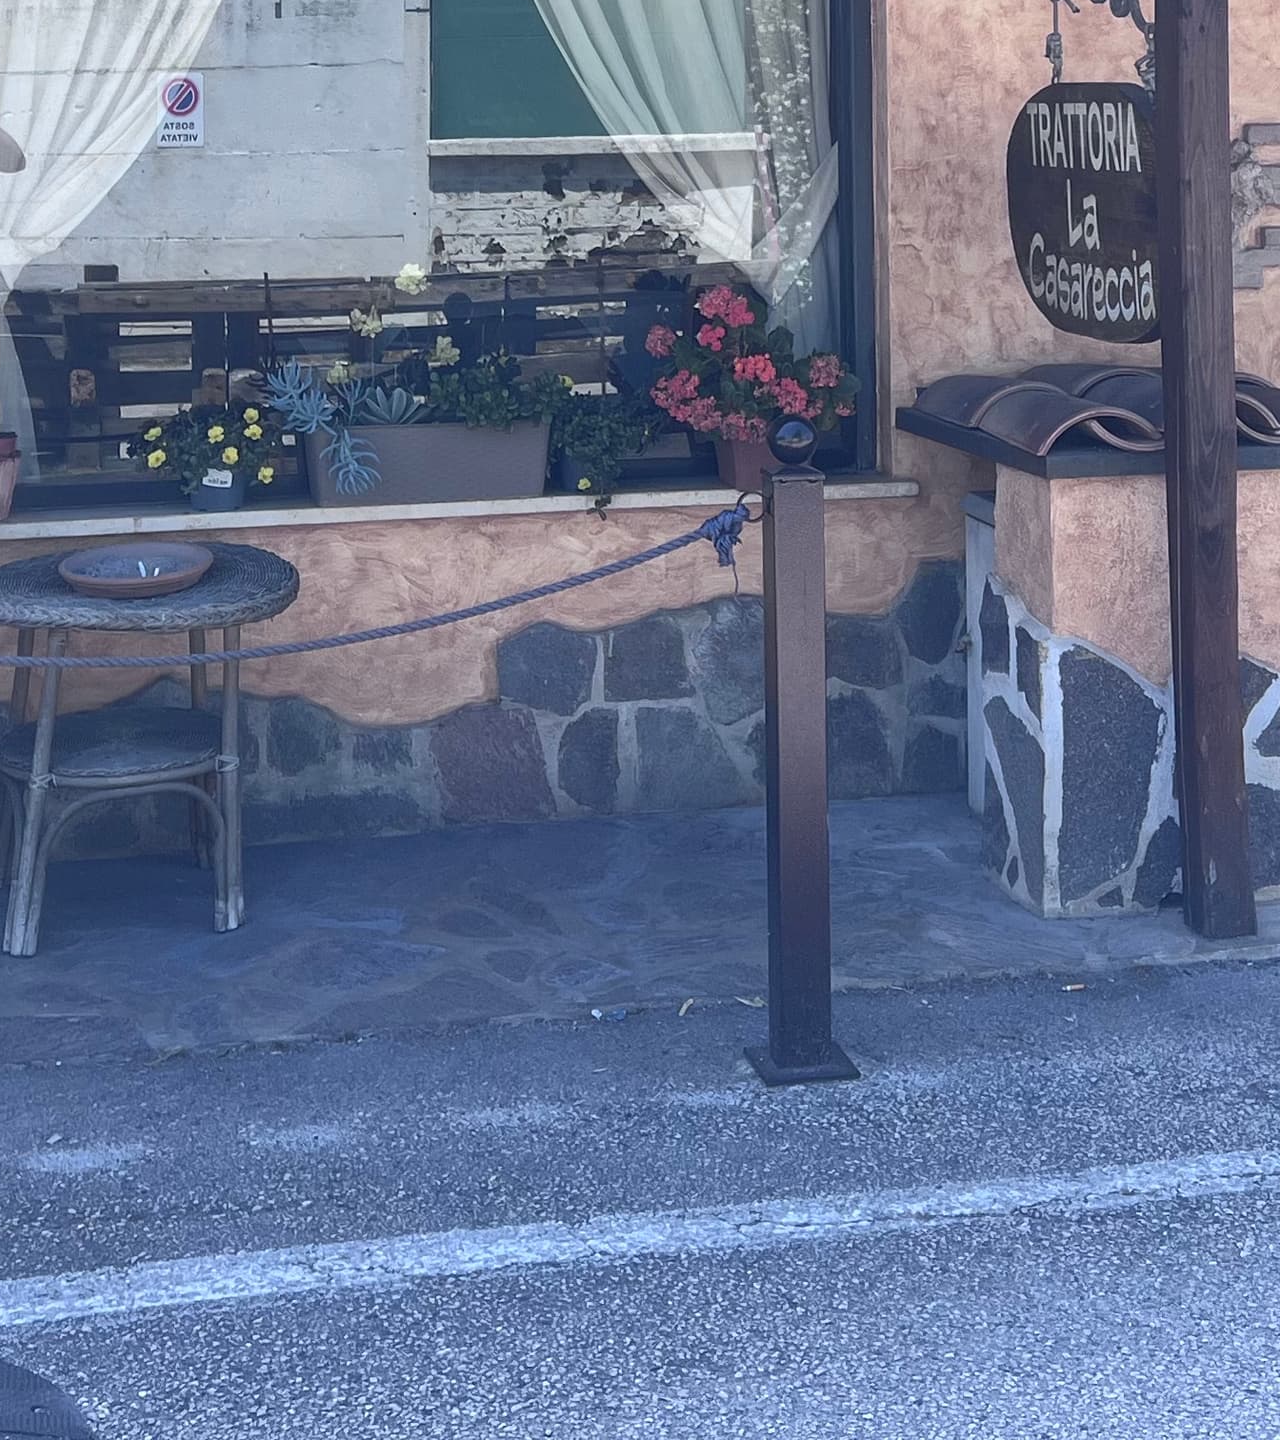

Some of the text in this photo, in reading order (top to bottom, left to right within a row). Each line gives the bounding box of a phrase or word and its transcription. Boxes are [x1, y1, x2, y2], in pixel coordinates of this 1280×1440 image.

[1026, 101, 1142, 173] TRATTORIA
[1066, 178, 1100, 250] La
[1029, 232, 1156, 322] Casareccia
